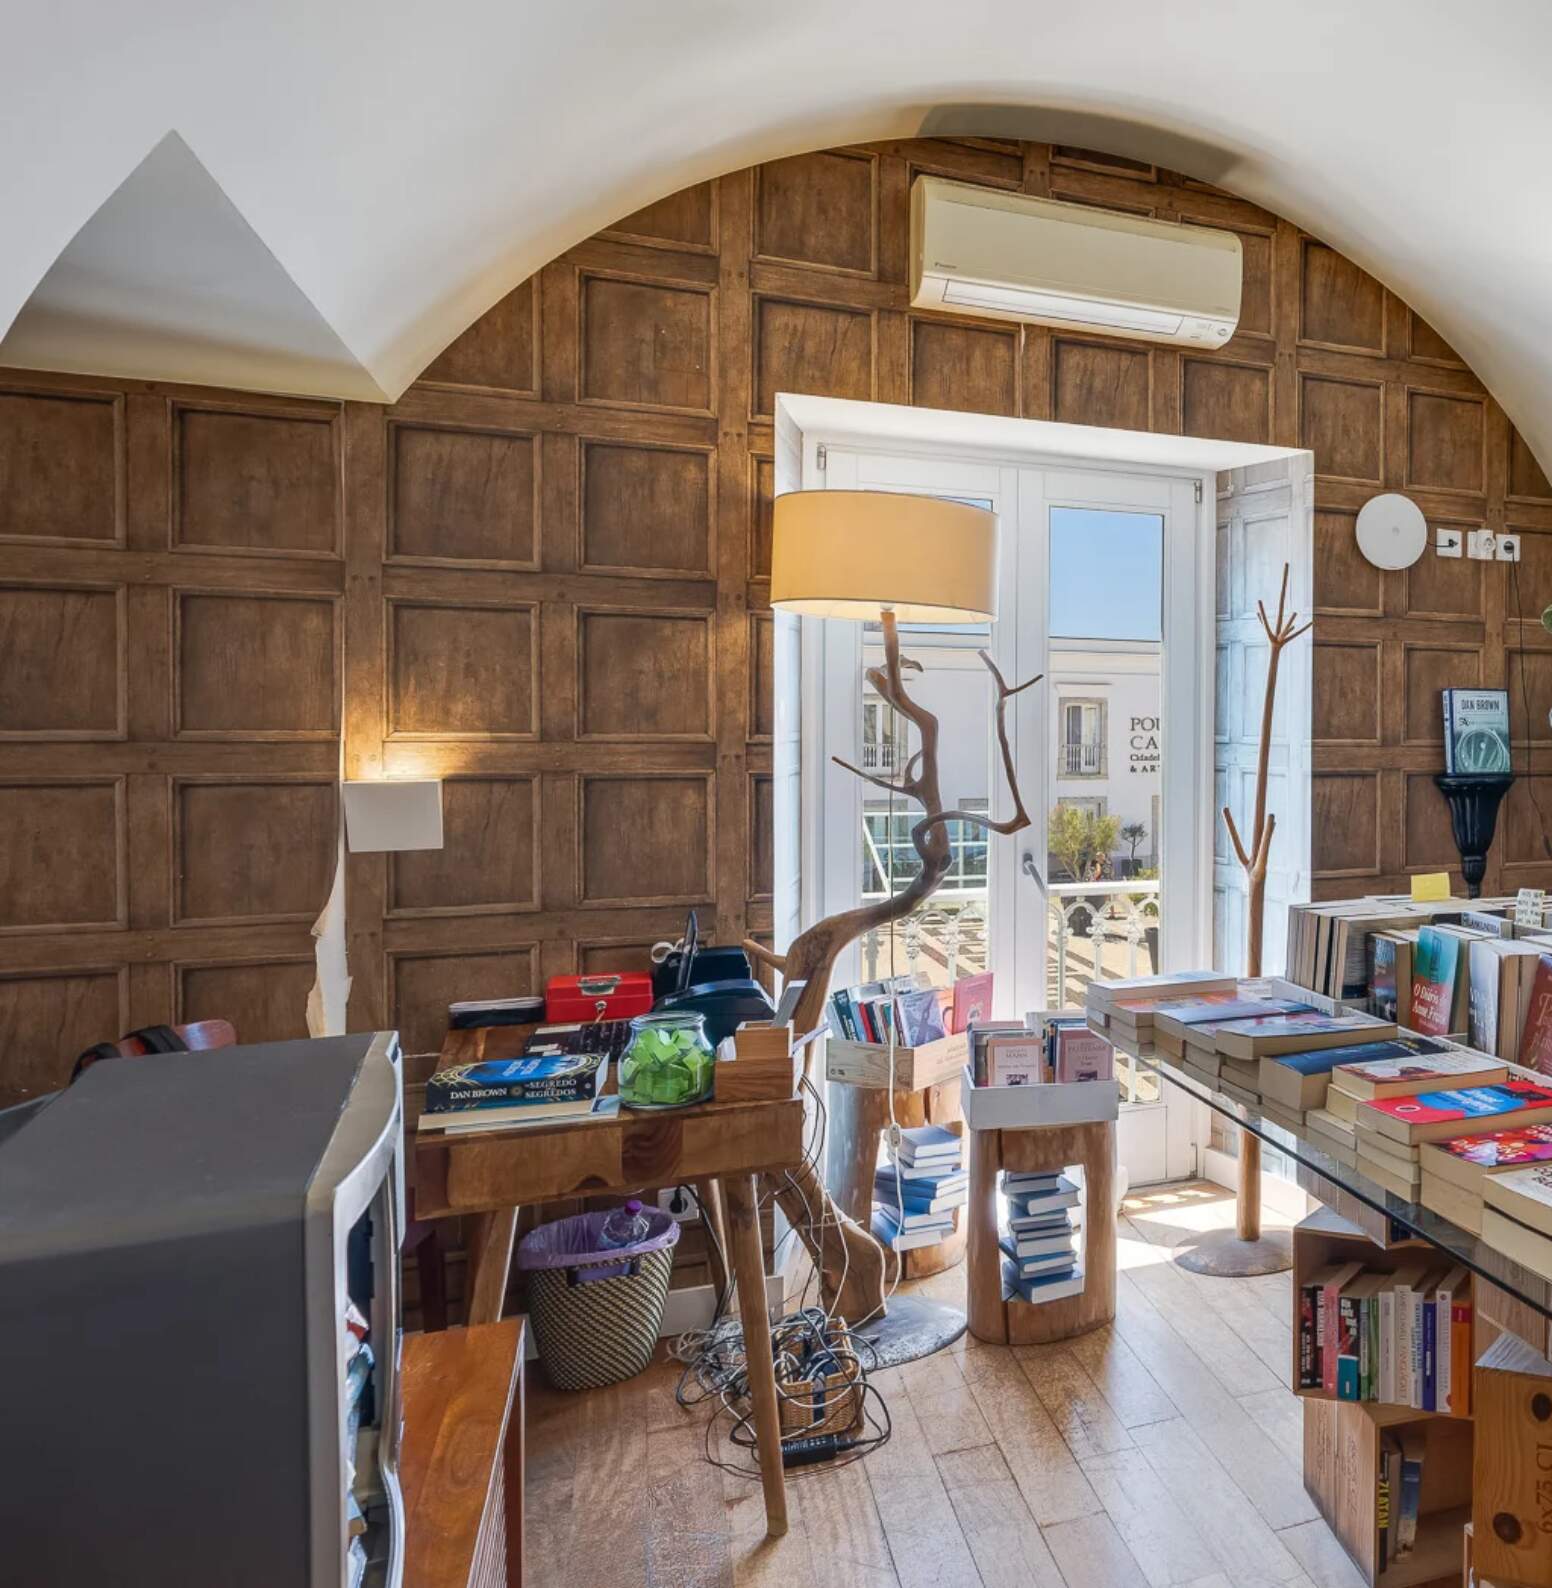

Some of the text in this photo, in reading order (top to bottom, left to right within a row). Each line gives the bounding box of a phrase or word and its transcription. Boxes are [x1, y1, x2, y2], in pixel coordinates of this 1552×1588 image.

[1461, 699, 1500, 710] DAN BROWN
[528, 1078, 577, 1090] SEGREDO
[450, 1087, 508, 1099] DAN BROWN
[524, 1087, 577, 1098] SEGREDOS
[1378, 1479, 1389, 1529] ZLATAN
